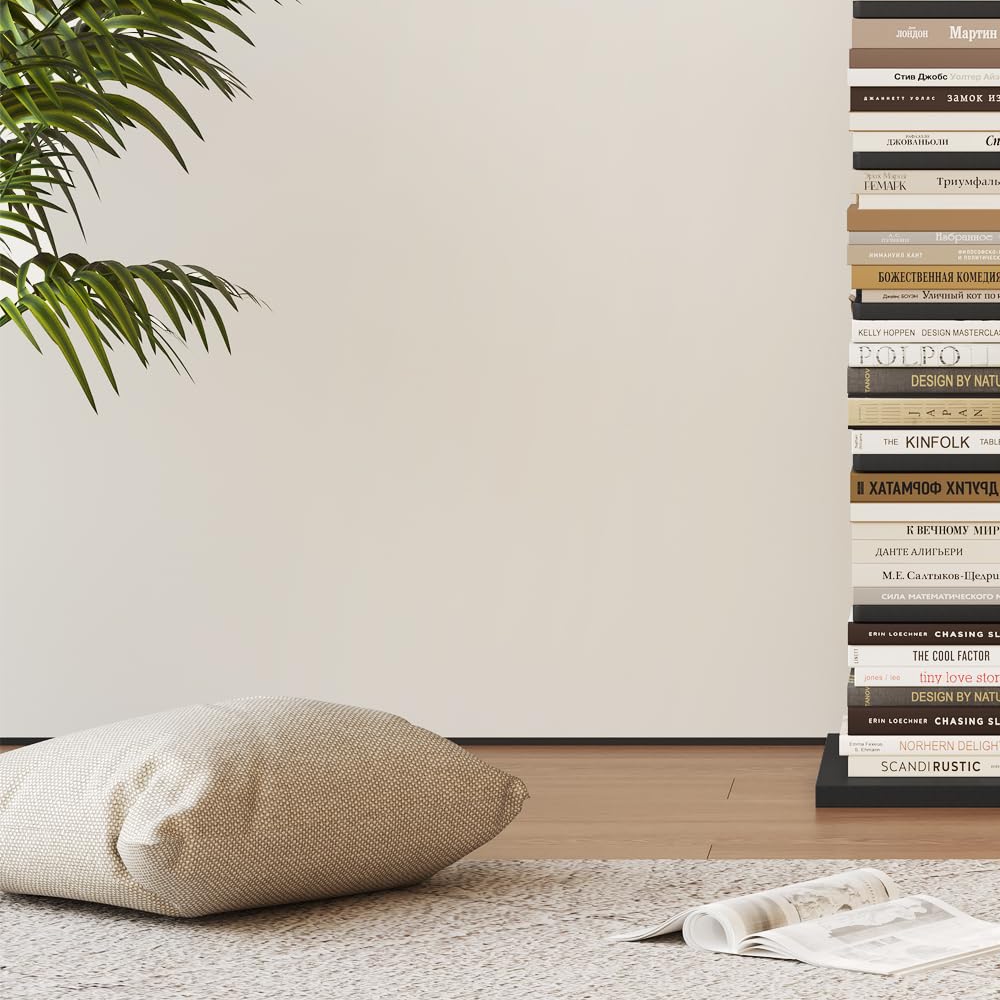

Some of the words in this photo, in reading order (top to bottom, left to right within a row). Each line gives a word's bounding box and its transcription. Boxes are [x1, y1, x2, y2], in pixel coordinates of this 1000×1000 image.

[949, 26, 997, 42] Мартин
[918, 73, 948, 81] Джобс
[887, 138, 949, 146] ДЖОВАНЬОЛИ
[936, 232, 993, 243] Избранное
[878, 272, 954, 283] БОЖЕСТВЕННАЯ
[923, 291, 964, 300] Уличный
[966, 292, 982, 300] кот
[985, 292, 997, 300] по
[859, 346, 961, 365] POLPO
[912, 375, 953, 387] DESIGN
[957, 375, 972, 387] BY
[906, 436, 970, 449] KINFOLK
[907, 526, 914, 535] К
[917, 525, 968, 535] ВЕЧНОМУ
[875, 548, 909, 557] ДАНТЕ
[911, 548, 963, 556] АЛИГЬЕРИ
[882, 571, 905, 580] М.Е.
[913, 651, 929, 661] THE
[933, 651, 955, 661] COOL
[957, 651, 990, 661] FACTOR
[920, 672, 942, 685] tiny
[946, 672, 972, 683] love
[912, 692, 953, 702] DESIGN
[957, 692, 972, 702] BY
[934, 717, 984, 726] CHASING
[899, 741, 955, 751] NORHERN
